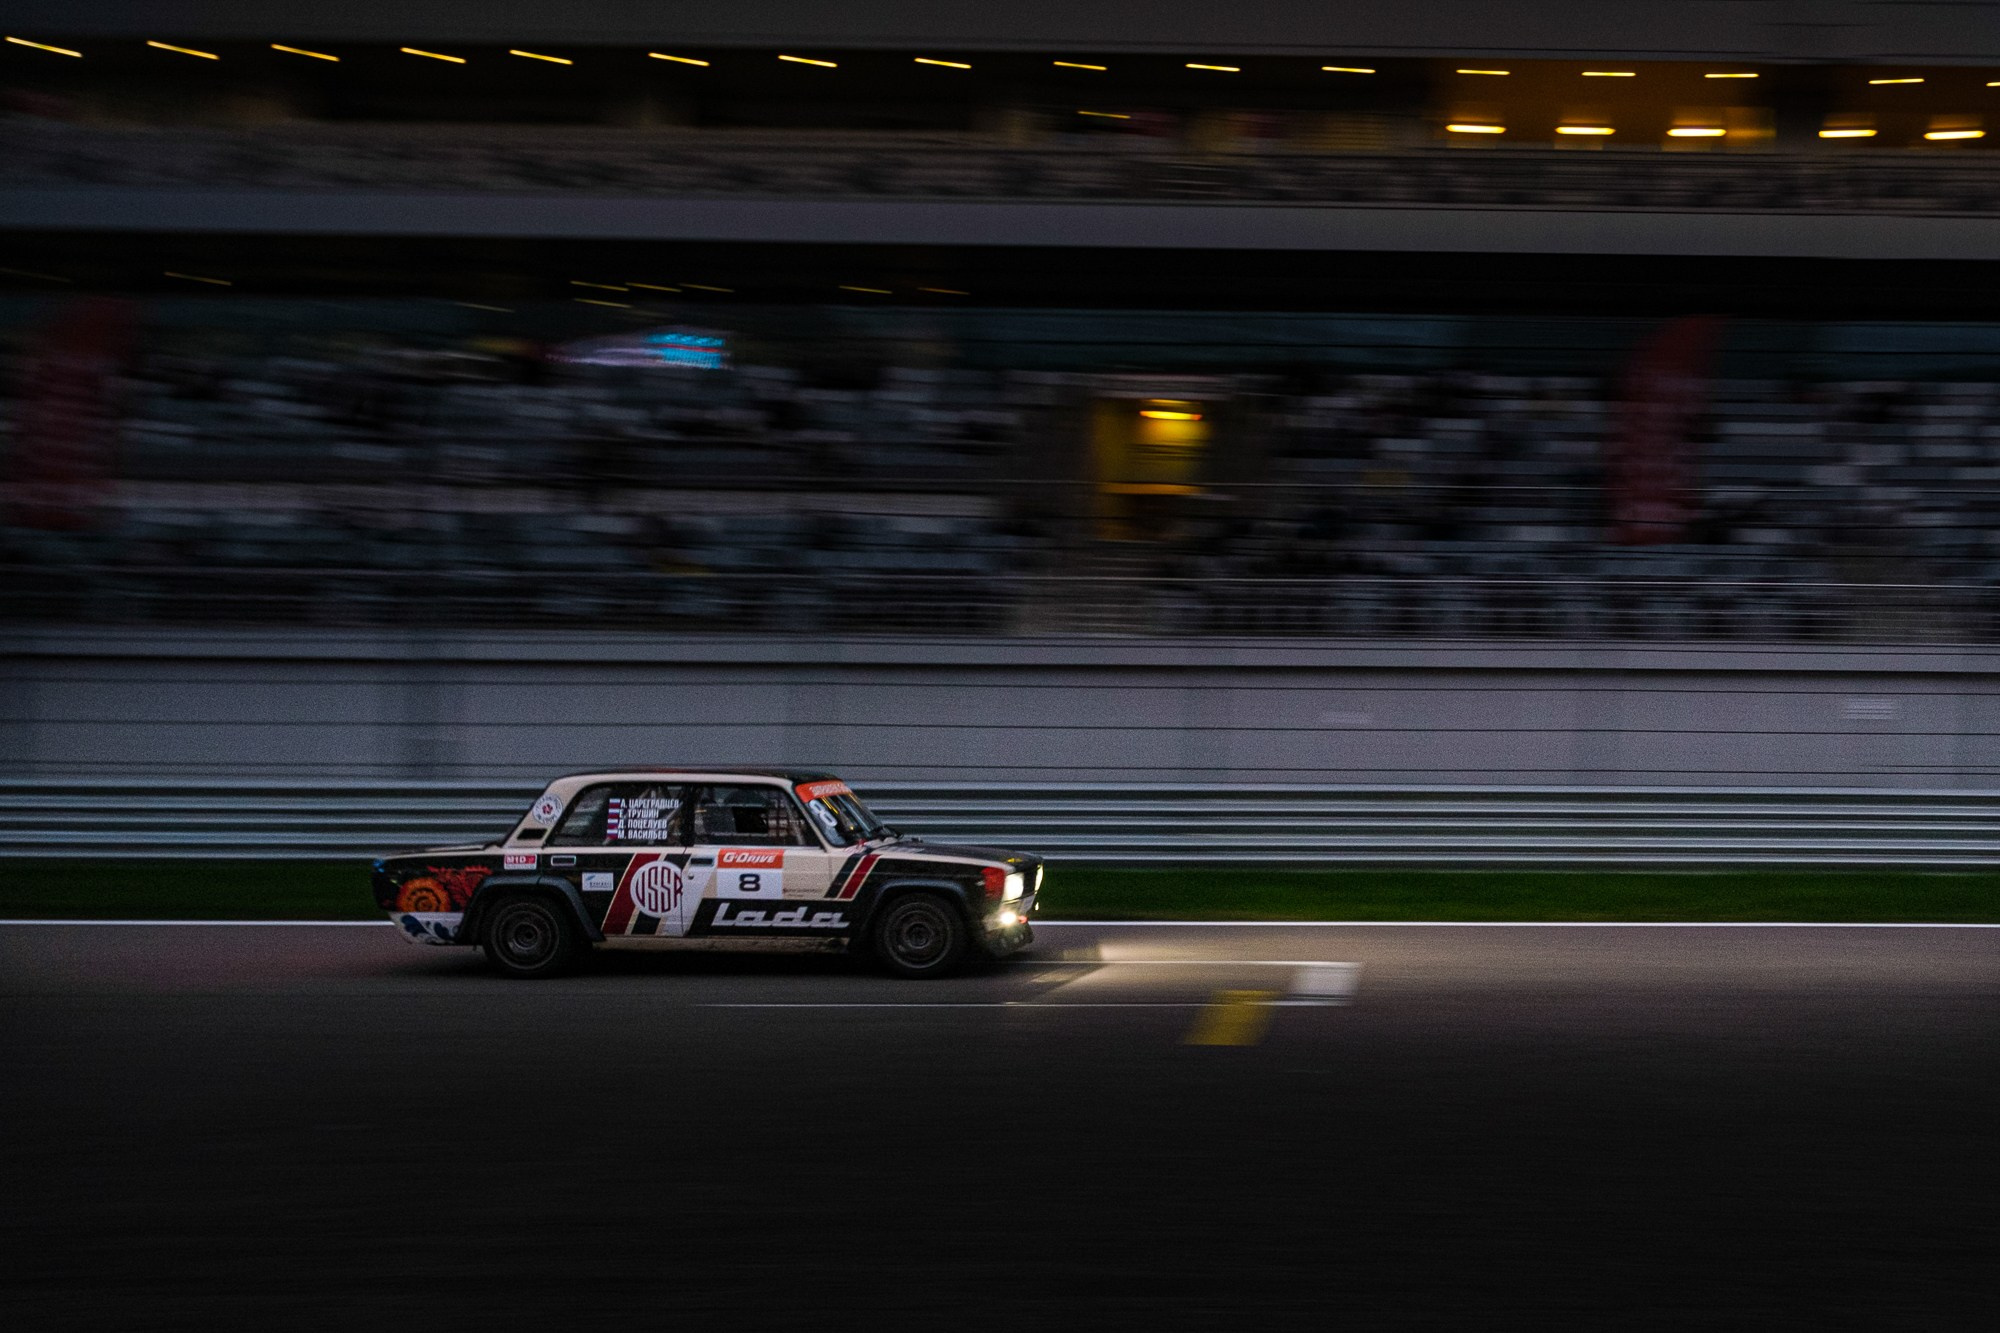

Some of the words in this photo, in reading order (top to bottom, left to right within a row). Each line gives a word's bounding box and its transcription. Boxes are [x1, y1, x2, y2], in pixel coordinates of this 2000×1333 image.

[620, 798, 628, 809] А.
[628, 798, 680, 810] ЦАРЕГРАДЦЕВ
[628, 808, 660, 819] ТРУШИН
[808, 799, 838, 827] 8
[627, 818, 668, 830] ПОЦЕЛУЕВ
[617, 829, 627, 840] М.
[627, 829, 668, 840] ВАСИЛЬЕВ
[635, 866, 683, 913] USSR
[739, 873, 760, 892] 8
[710, 902, 851, 929] Lada
